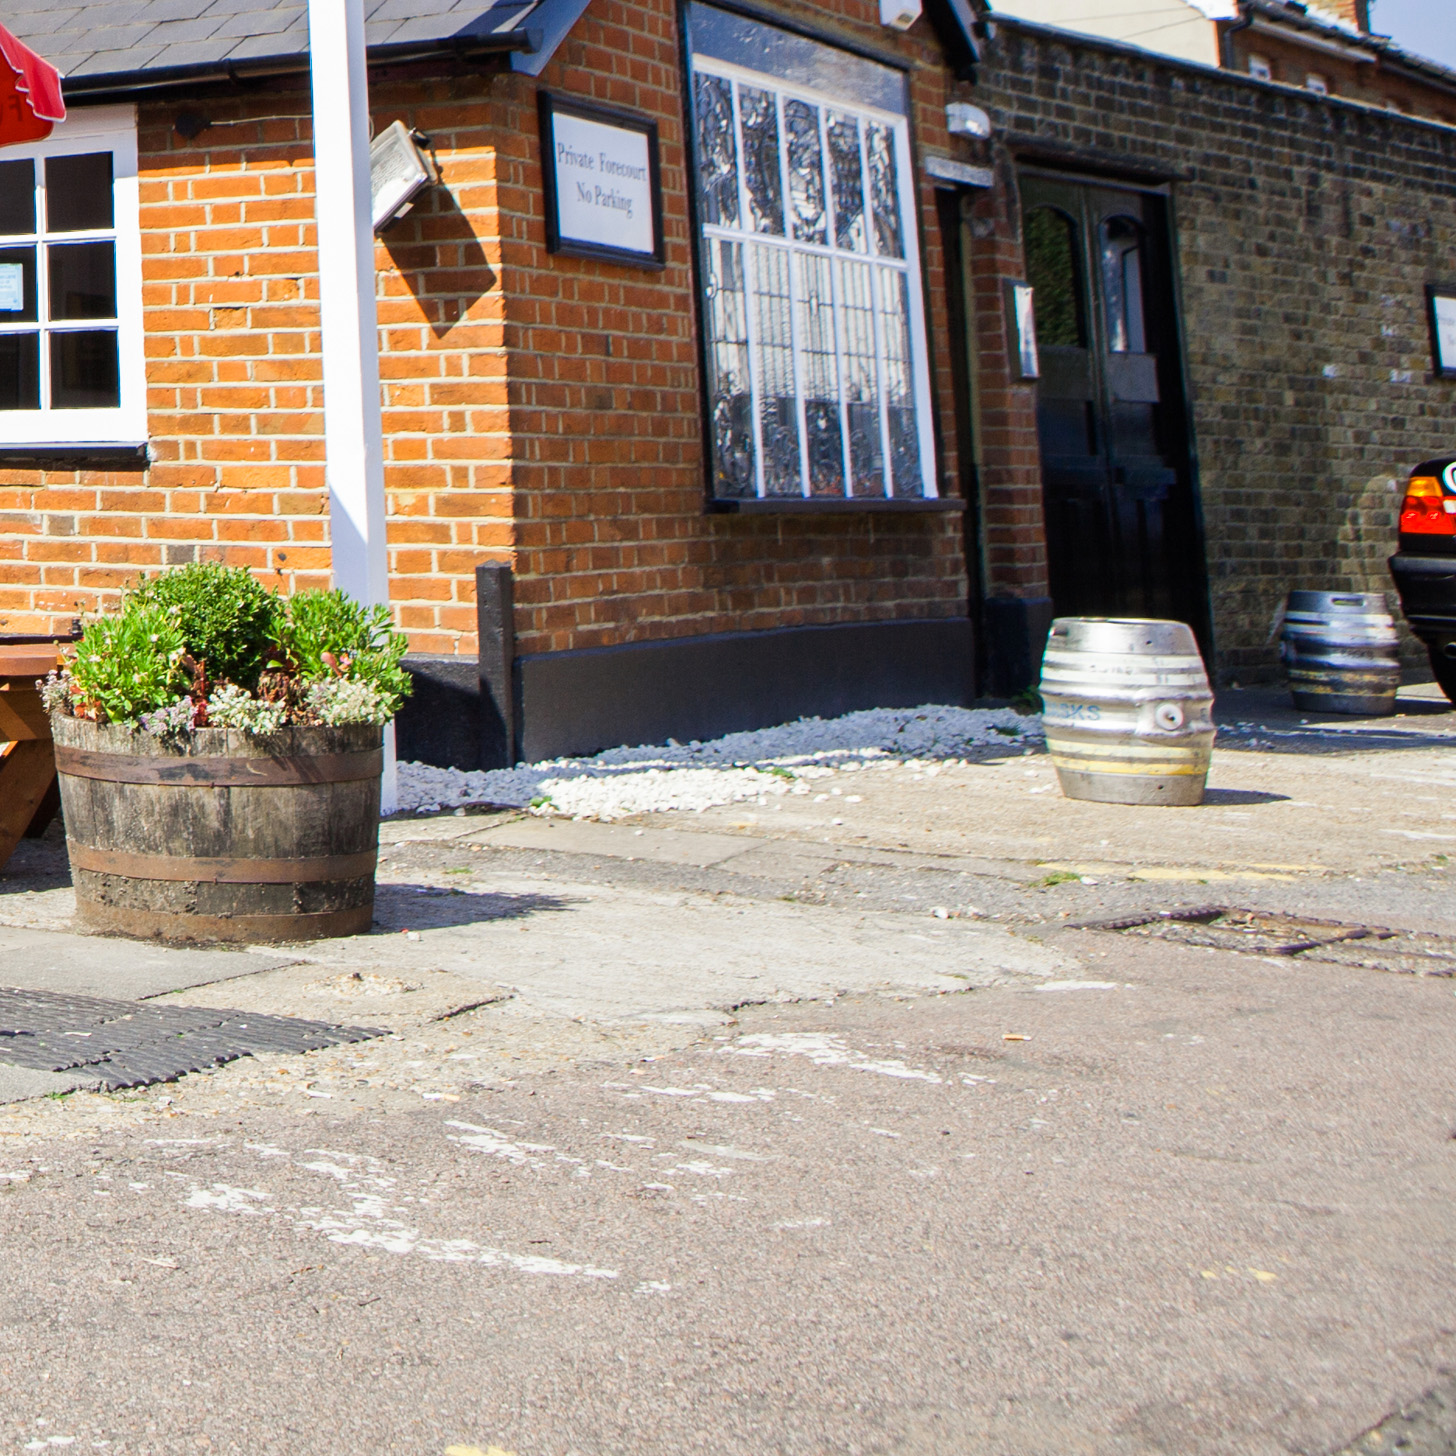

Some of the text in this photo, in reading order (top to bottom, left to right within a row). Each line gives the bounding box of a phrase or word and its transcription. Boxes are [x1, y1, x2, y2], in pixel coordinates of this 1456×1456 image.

[557, 142, 646, 181] Private Forecourt
[576, 181, 633, 219] No Parking
